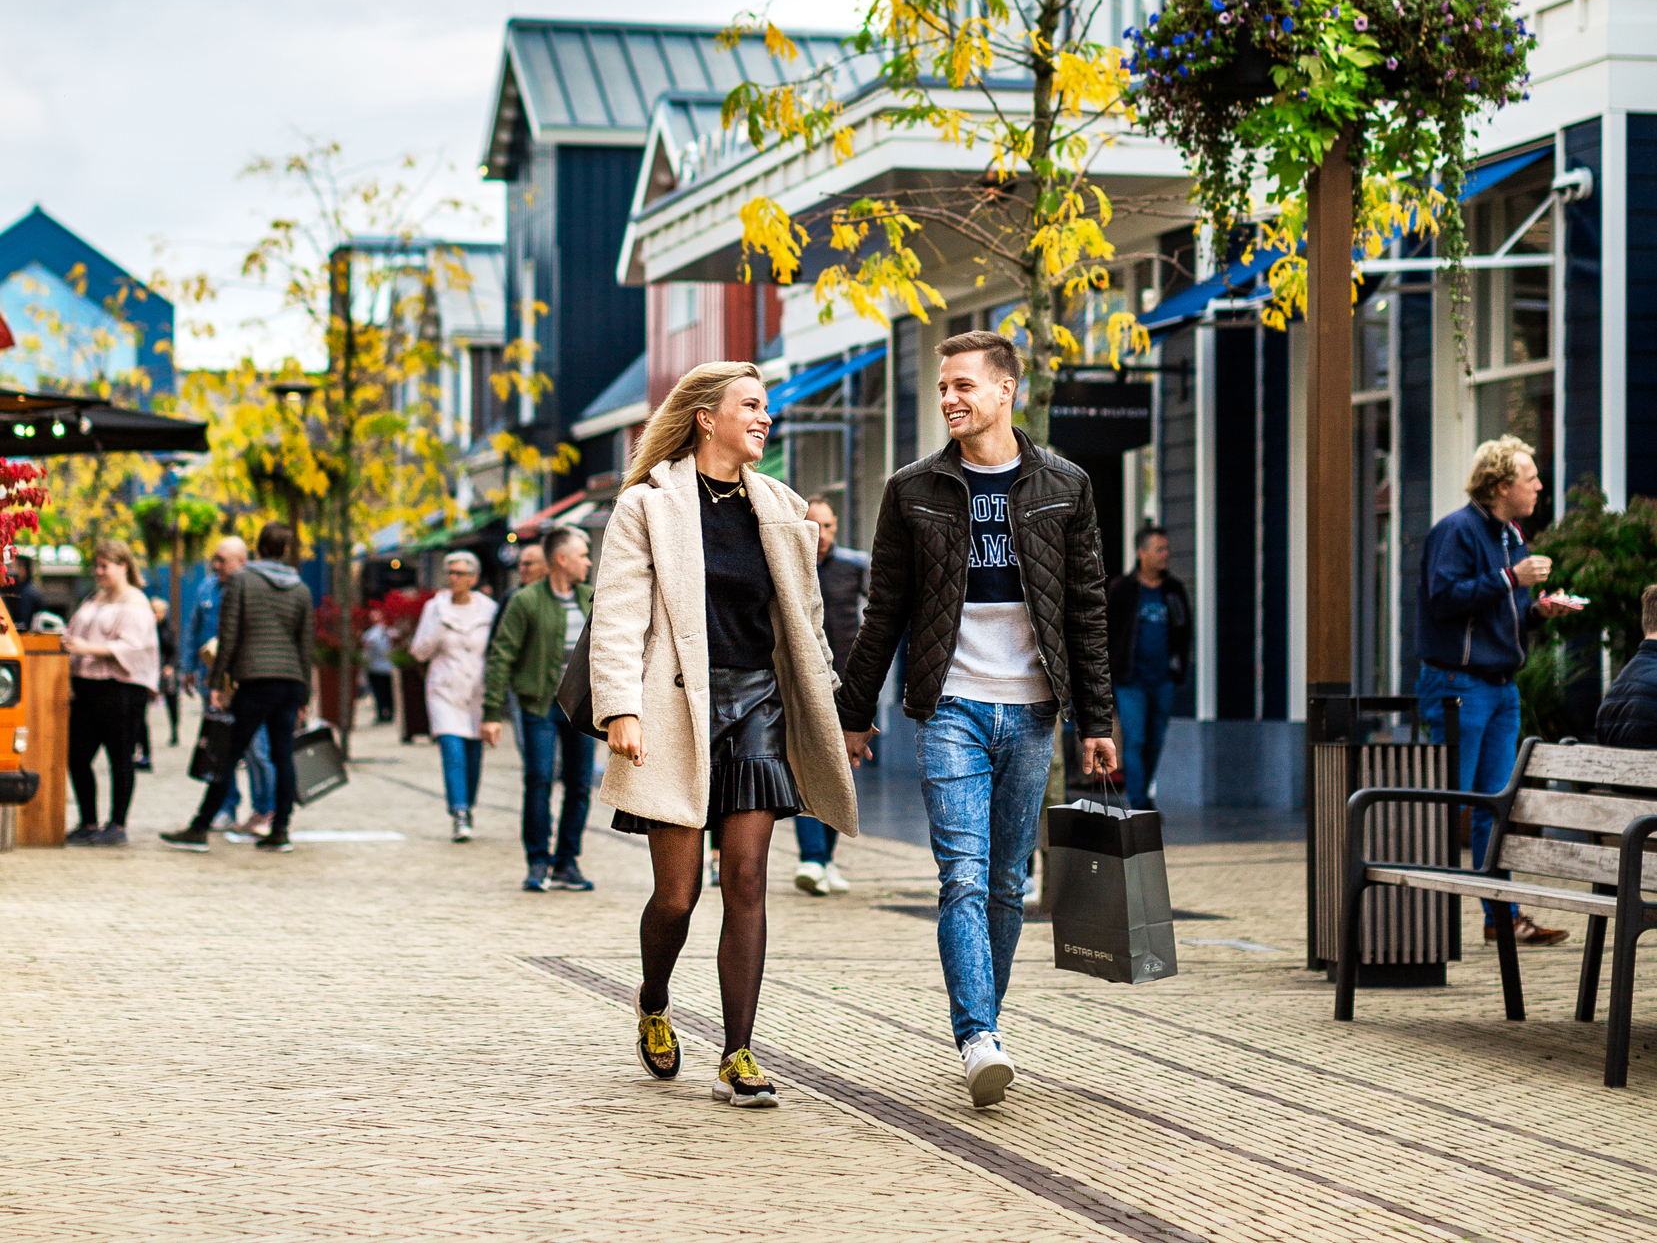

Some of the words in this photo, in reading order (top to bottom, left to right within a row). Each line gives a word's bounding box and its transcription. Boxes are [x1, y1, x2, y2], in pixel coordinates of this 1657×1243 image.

[970, 494, 1008, 522] OT
[1064, 943, 1093, 958] G-STAR
[1094, 950, 1114, 962] RAW
